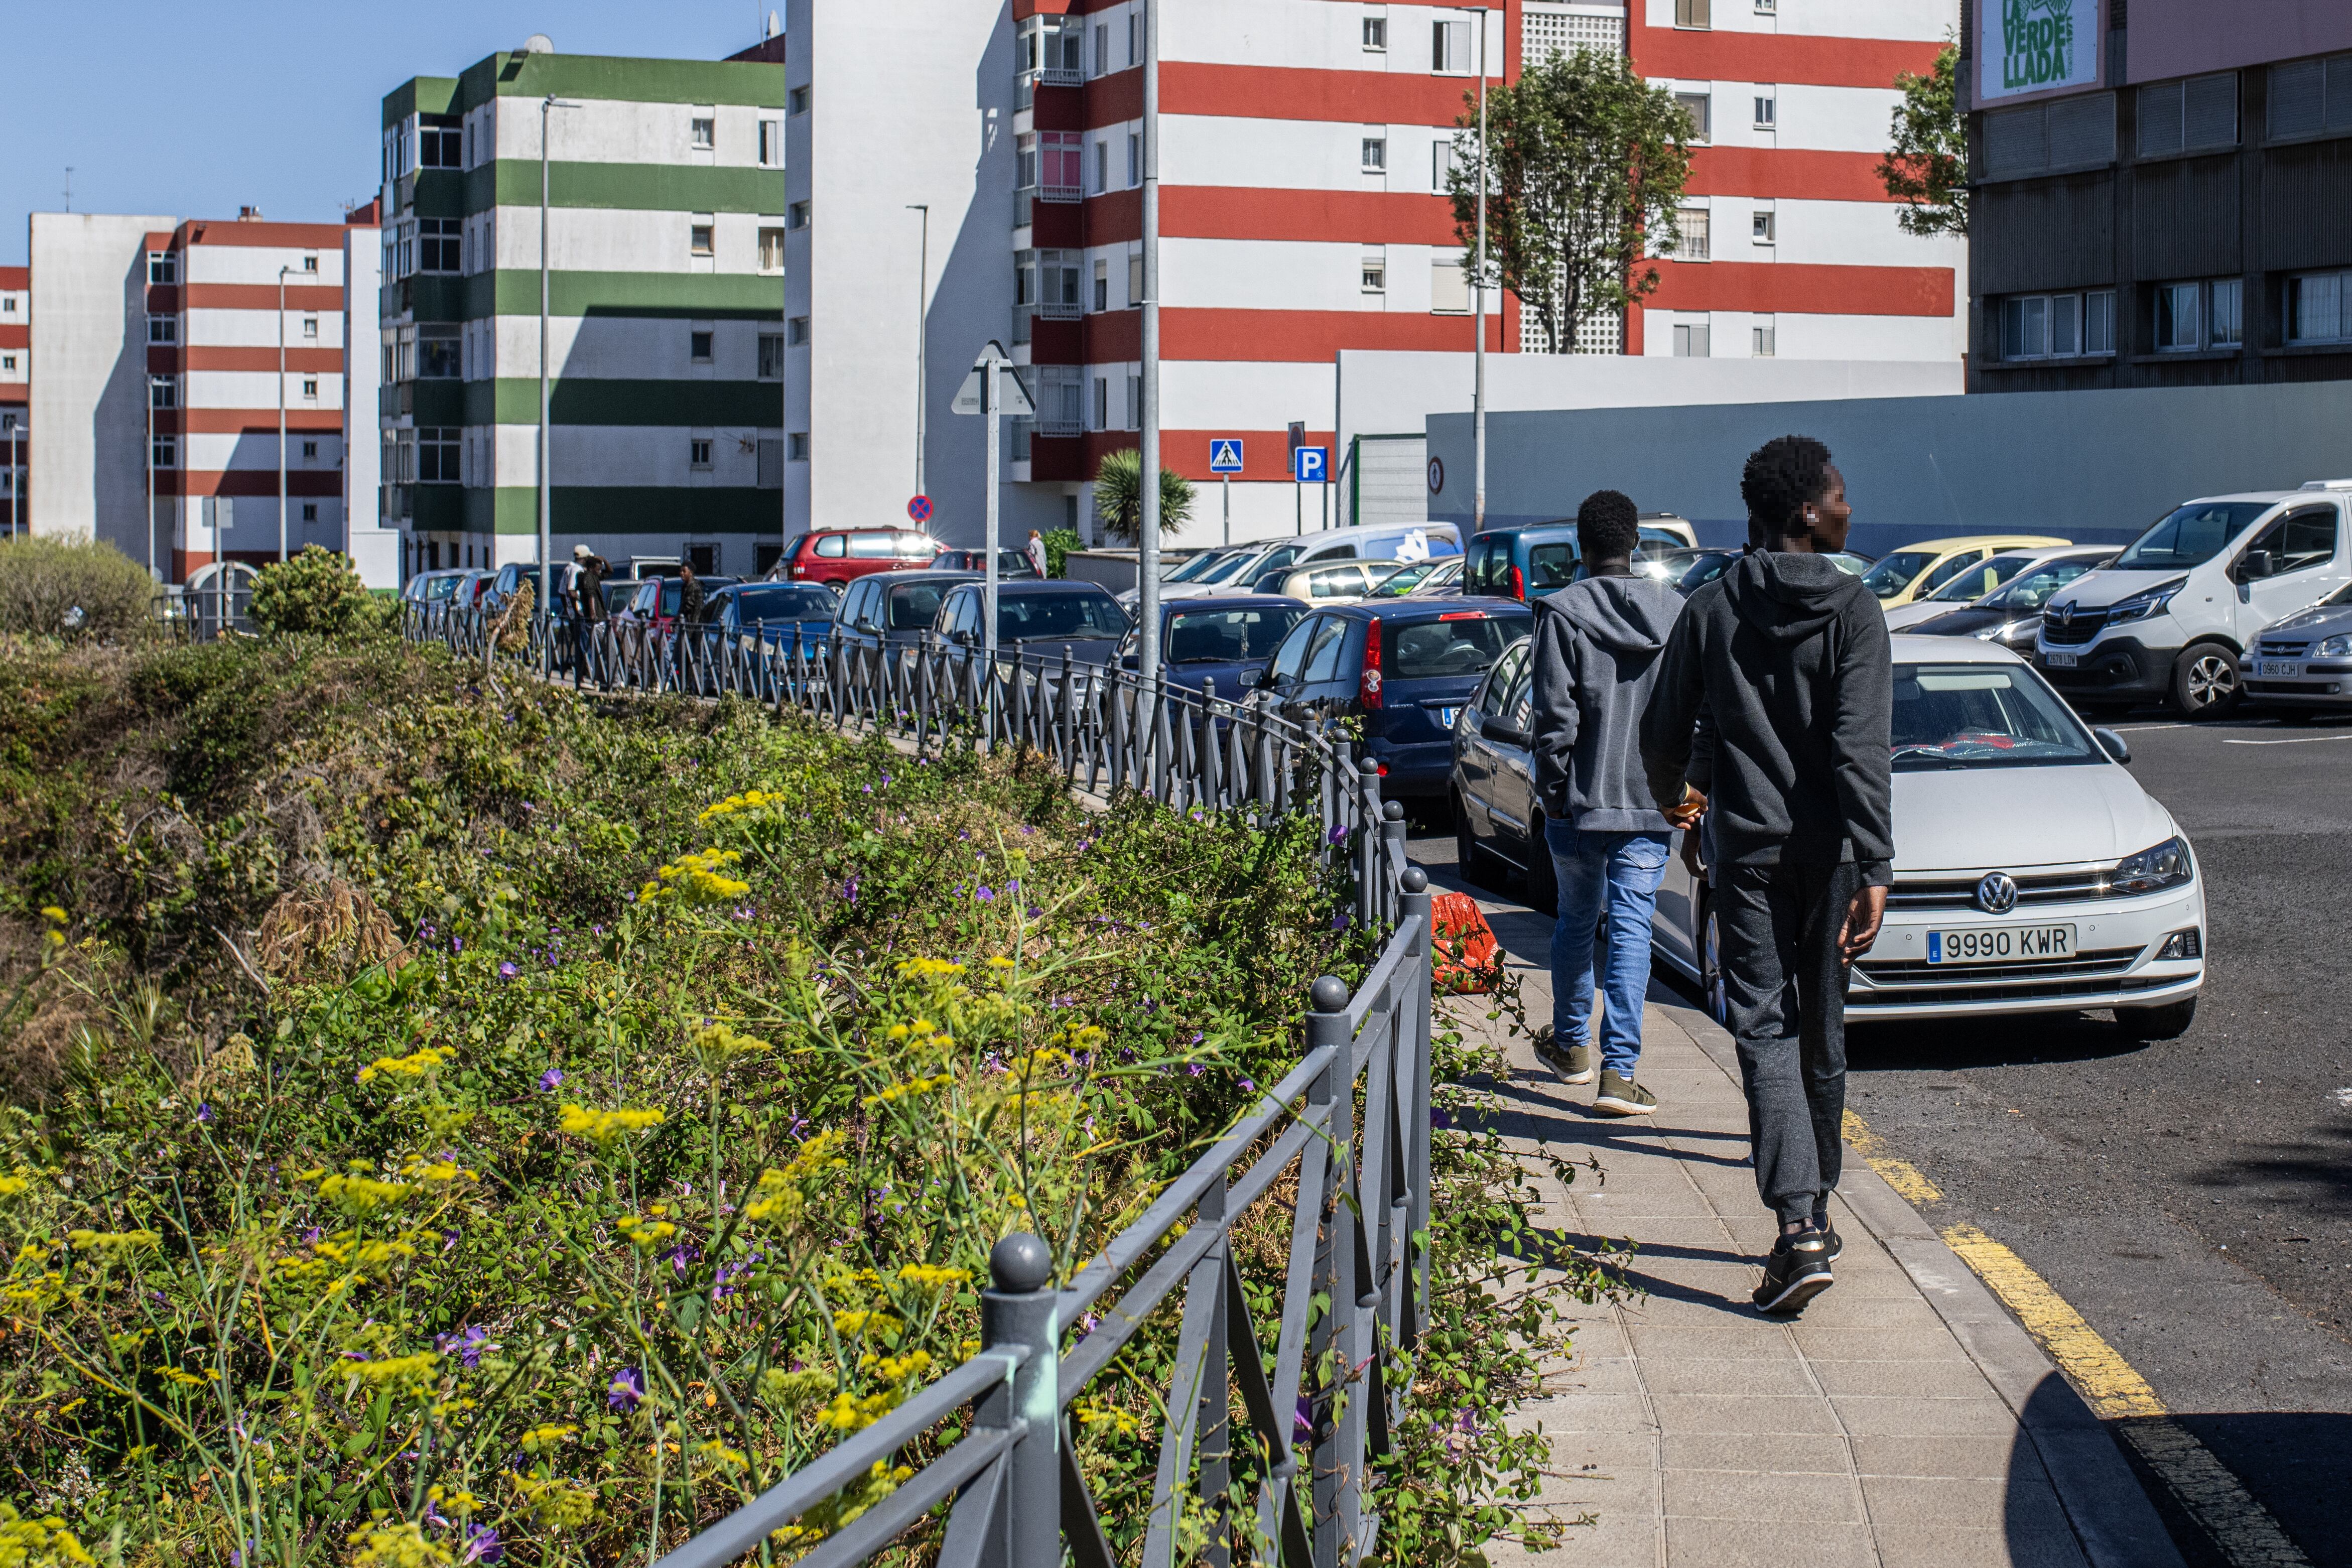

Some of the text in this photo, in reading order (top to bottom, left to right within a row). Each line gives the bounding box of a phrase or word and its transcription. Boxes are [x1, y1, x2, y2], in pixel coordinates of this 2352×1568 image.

[2003, 14, 2065, 56] VERDE
[2003, 47, 2066, 89] LLADA
[1302, 452, 1322, 478] P
[2049, 654, 2062, 664] 2678
[2263, 664, 2295, 675] 0960 CJH
[1946, 929, 2066, 958] 9990 KWR
